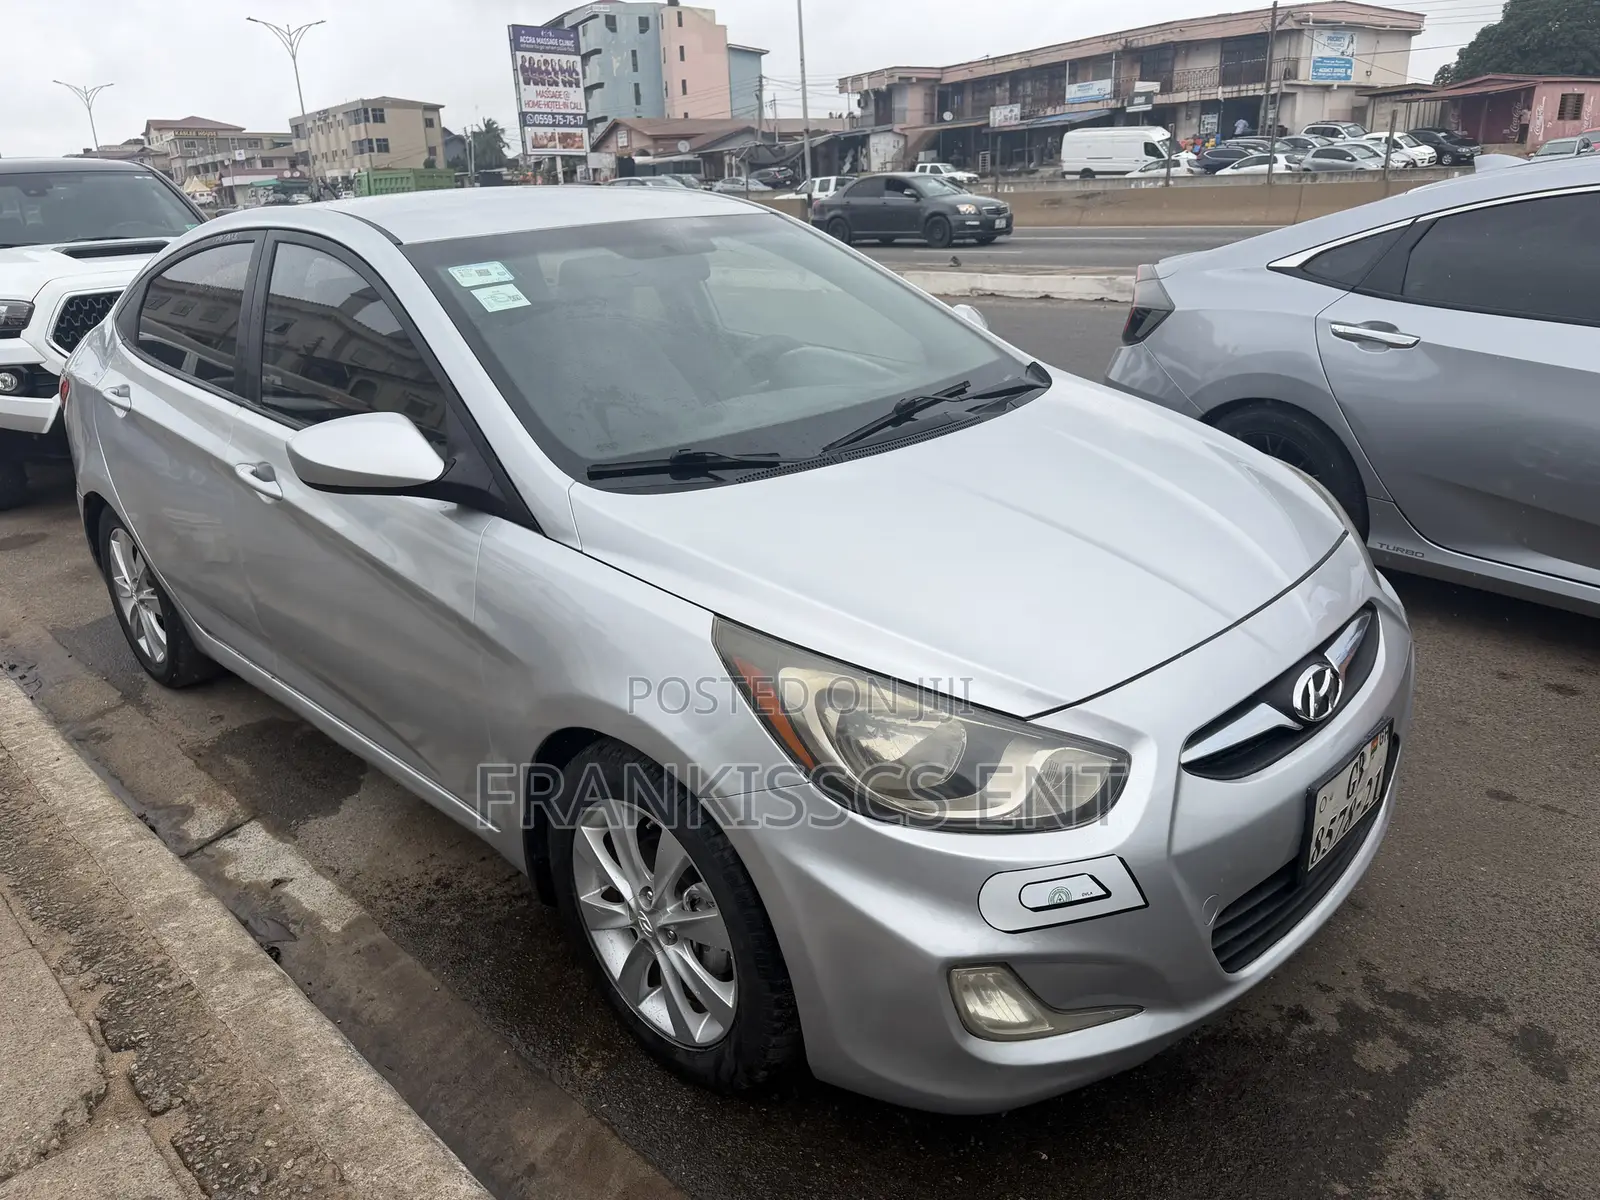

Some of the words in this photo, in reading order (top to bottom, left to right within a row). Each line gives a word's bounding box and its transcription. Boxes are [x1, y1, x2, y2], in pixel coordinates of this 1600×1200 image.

[520, 35, 536, 43] ACCRA
[536, 37, 558, 46] MASSAGE
[559, 39, 575, 47] CLINIC
[535, 90, 563, 99] MASSAGE
[570, 101, 584, 111] CALL
[534, 114, 584, 125] 0559-75-75-17
[1377, 542, 1425, 558] TURBO
[1311, 765, 1383, 866] 8578-21
